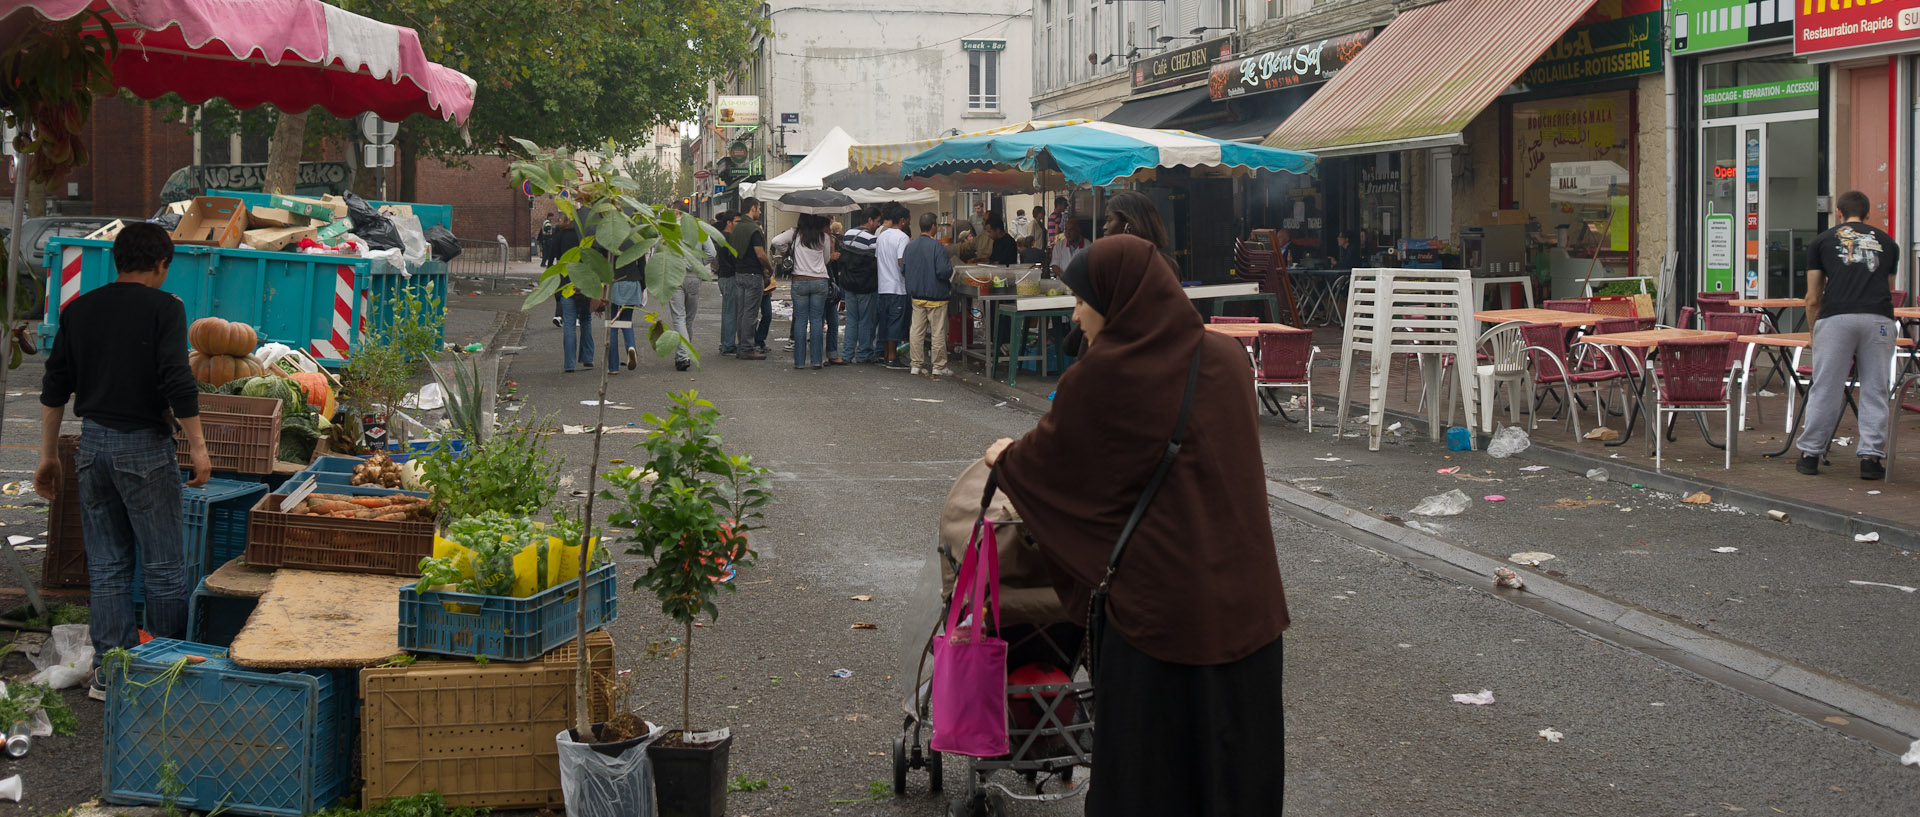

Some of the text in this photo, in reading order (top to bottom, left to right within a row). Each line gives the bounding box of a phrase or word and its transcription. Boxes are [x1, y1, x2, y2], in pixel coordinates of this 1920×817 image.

[1803, 16, 1893, 40] Restauration Rapide
[1904, 12, 1919, 26] SU
[1153, 47, 1207, 76] Café CHEZ BEN
[1239, 39, 1329, 87] Le Béni Saf
[1703, 90, 1738, 103] DEBLOCAGE
[1742, 85, 1780, 99] REPARATION
[1527, 108, 1613, 130] BOUCHERIE BASMALA
[1559, 177, 1578, 191] HALAL
[1747, 216, 1758, 226] SFR
